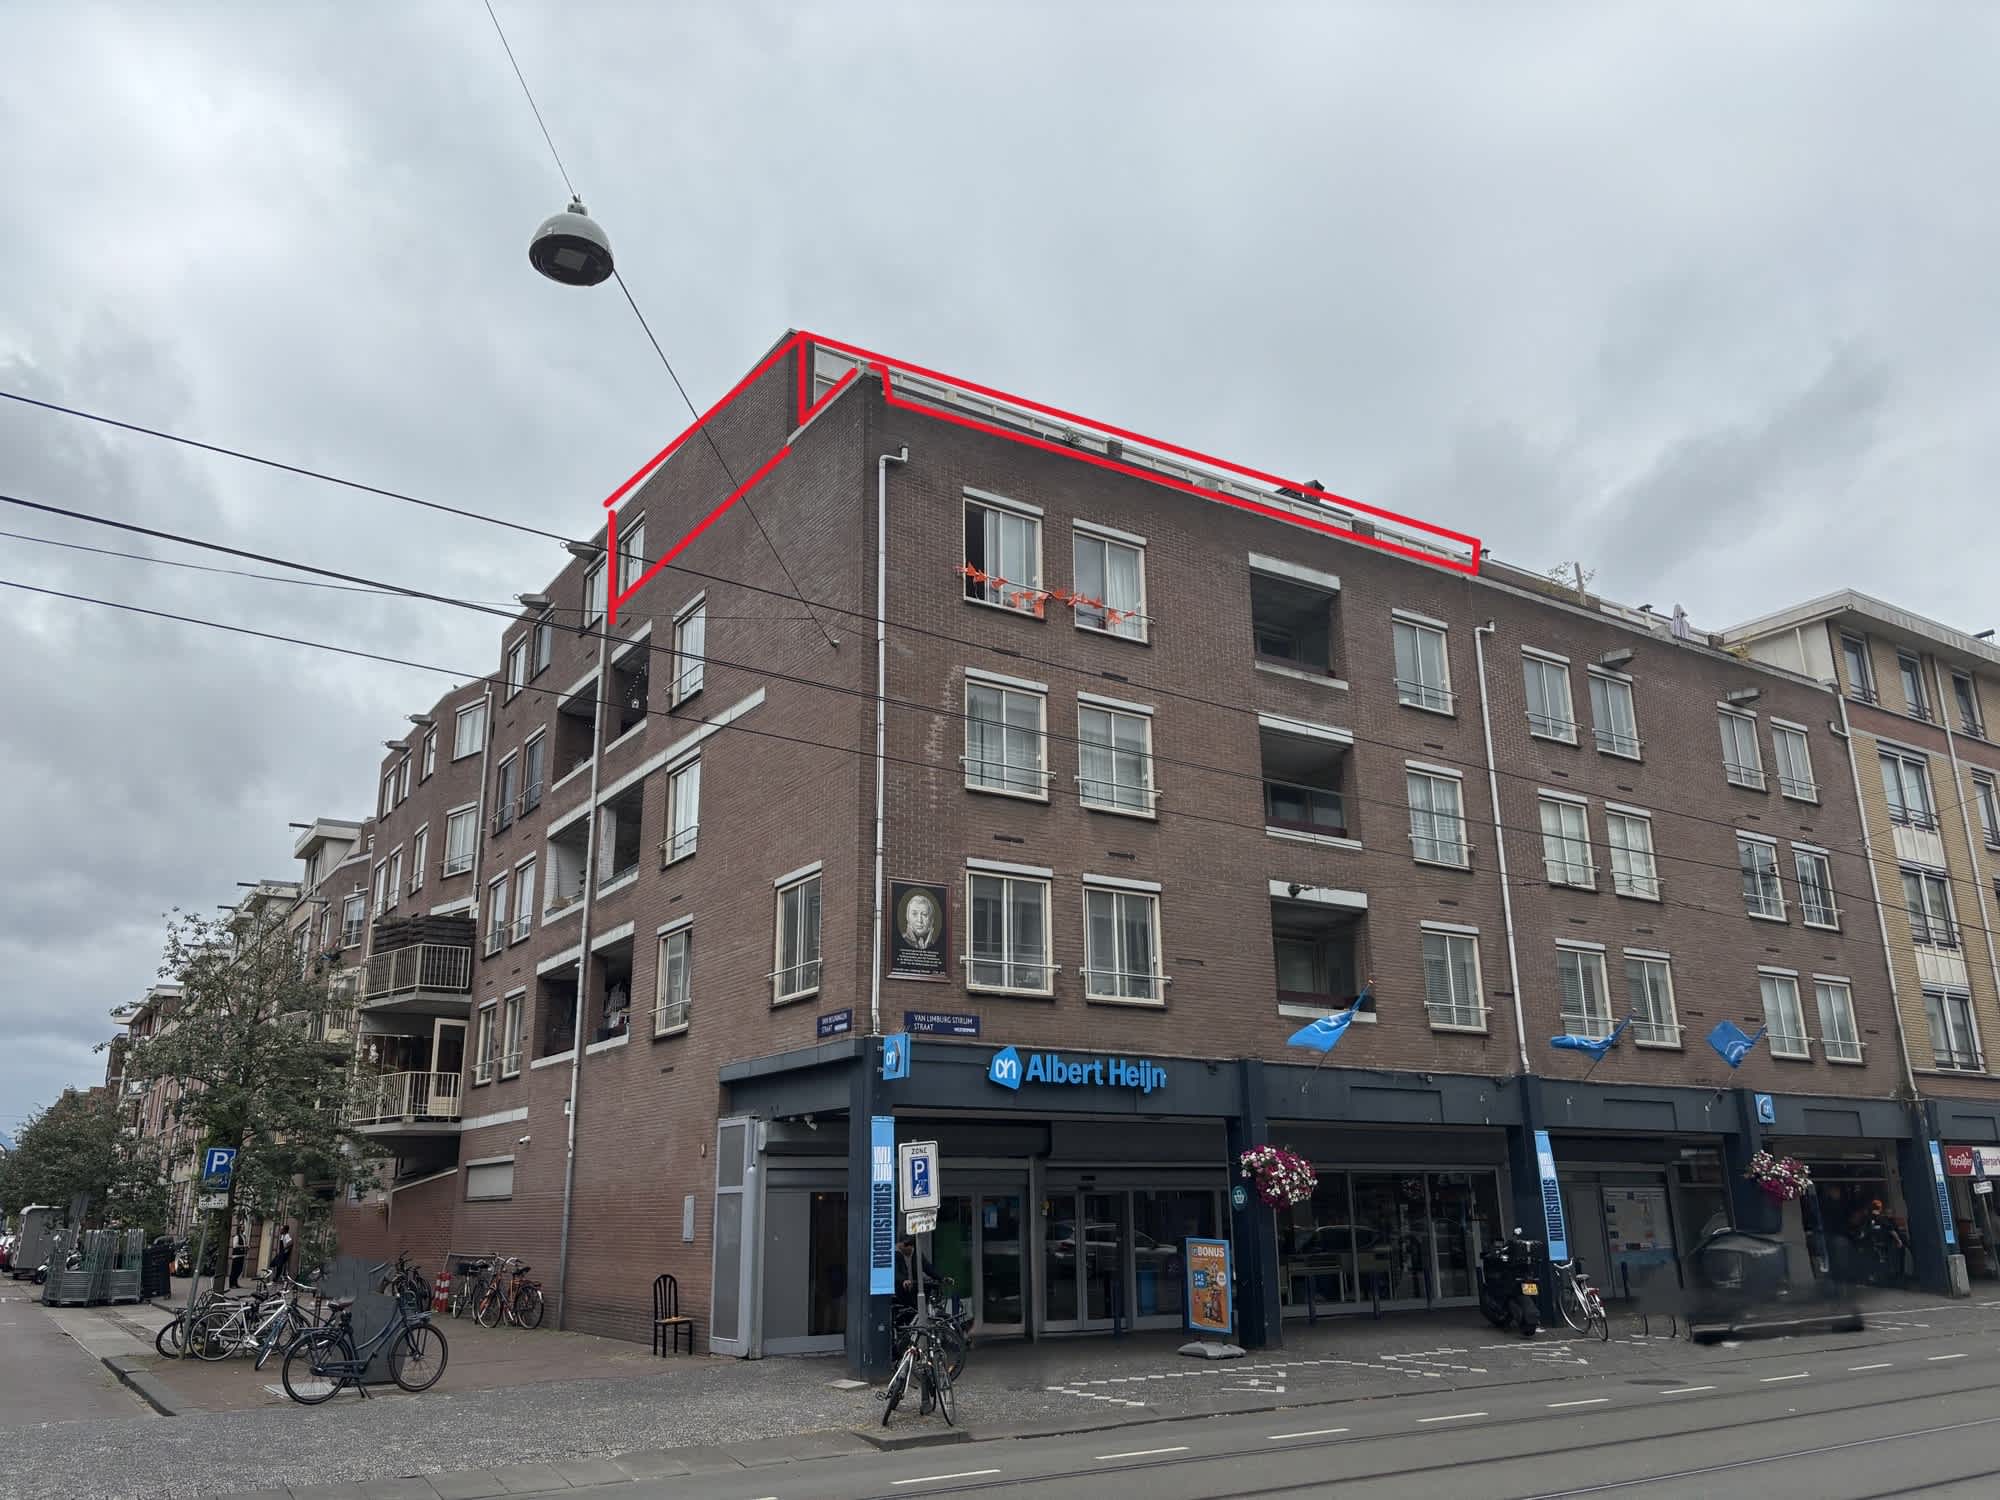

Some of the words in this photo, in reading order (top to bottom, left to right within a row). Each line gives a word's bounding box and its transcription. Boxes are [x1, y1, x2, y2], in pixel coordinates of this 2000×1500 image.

[926, 1015, 952, 1024] LIMBURG
[913, 1022, 934, 1031] STRAAT
[1025, 1054, 1104, 1085] Albert
[1108, 1058, 1167, 1093] Heijn
[911, 1147, 928, 1155] ZONE
[211, 1152, 229, 1172] P
[914, 1160, 925, 1180] P
[1197, 1246, 1225, 1257] BONUS
